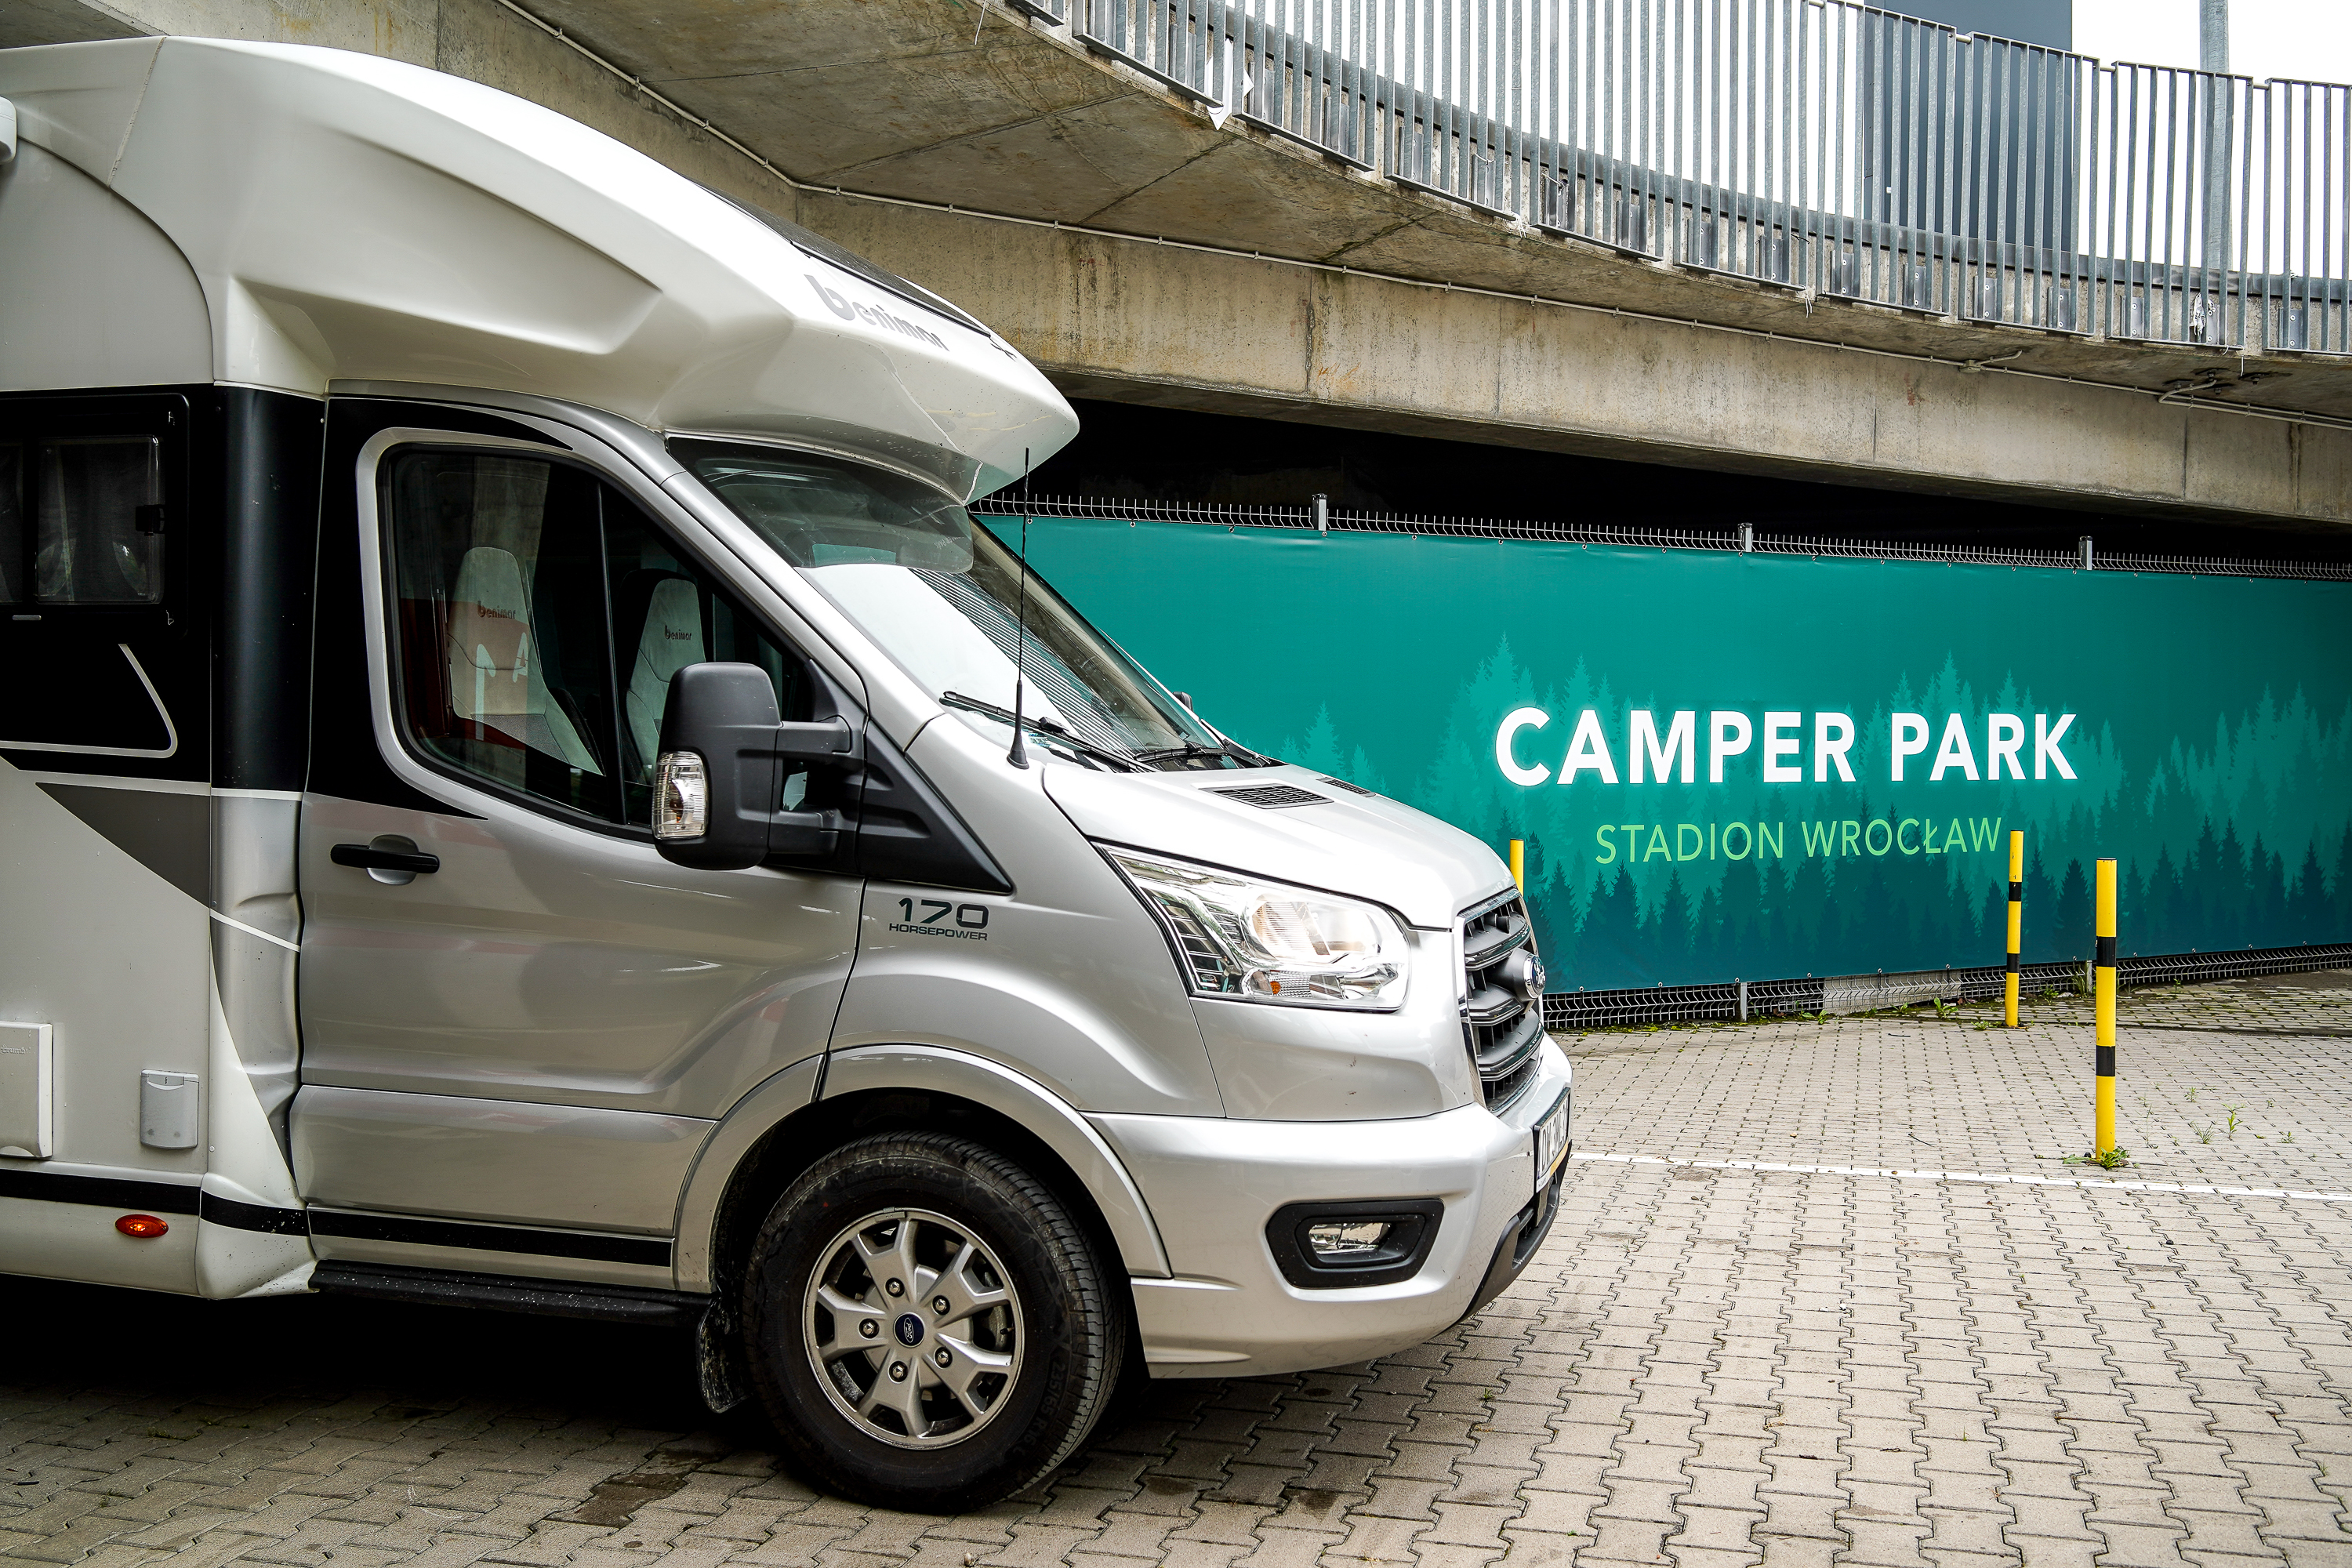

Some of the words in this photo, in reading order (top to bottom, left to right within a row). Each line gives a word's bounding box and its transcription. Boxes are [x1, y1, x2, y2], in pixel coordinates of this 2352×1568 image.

[804, 274, 950, 352] benimar
[477, 600, 517, 619] benimar
[664, 624, 692, 641] benimar
[1495, 706, 1857, 786] CAMPER
[1891, 713, 2078, 782] PARK
[1595, 821, 1784, 865] STADION
[1801, 816, 2002, 858] WROCŁAW
[888, 922, 989, 942] HORSEPOWER
[898, 896, 990, 930] 170
[1040, 1361, 1066, 1417] 235/65
